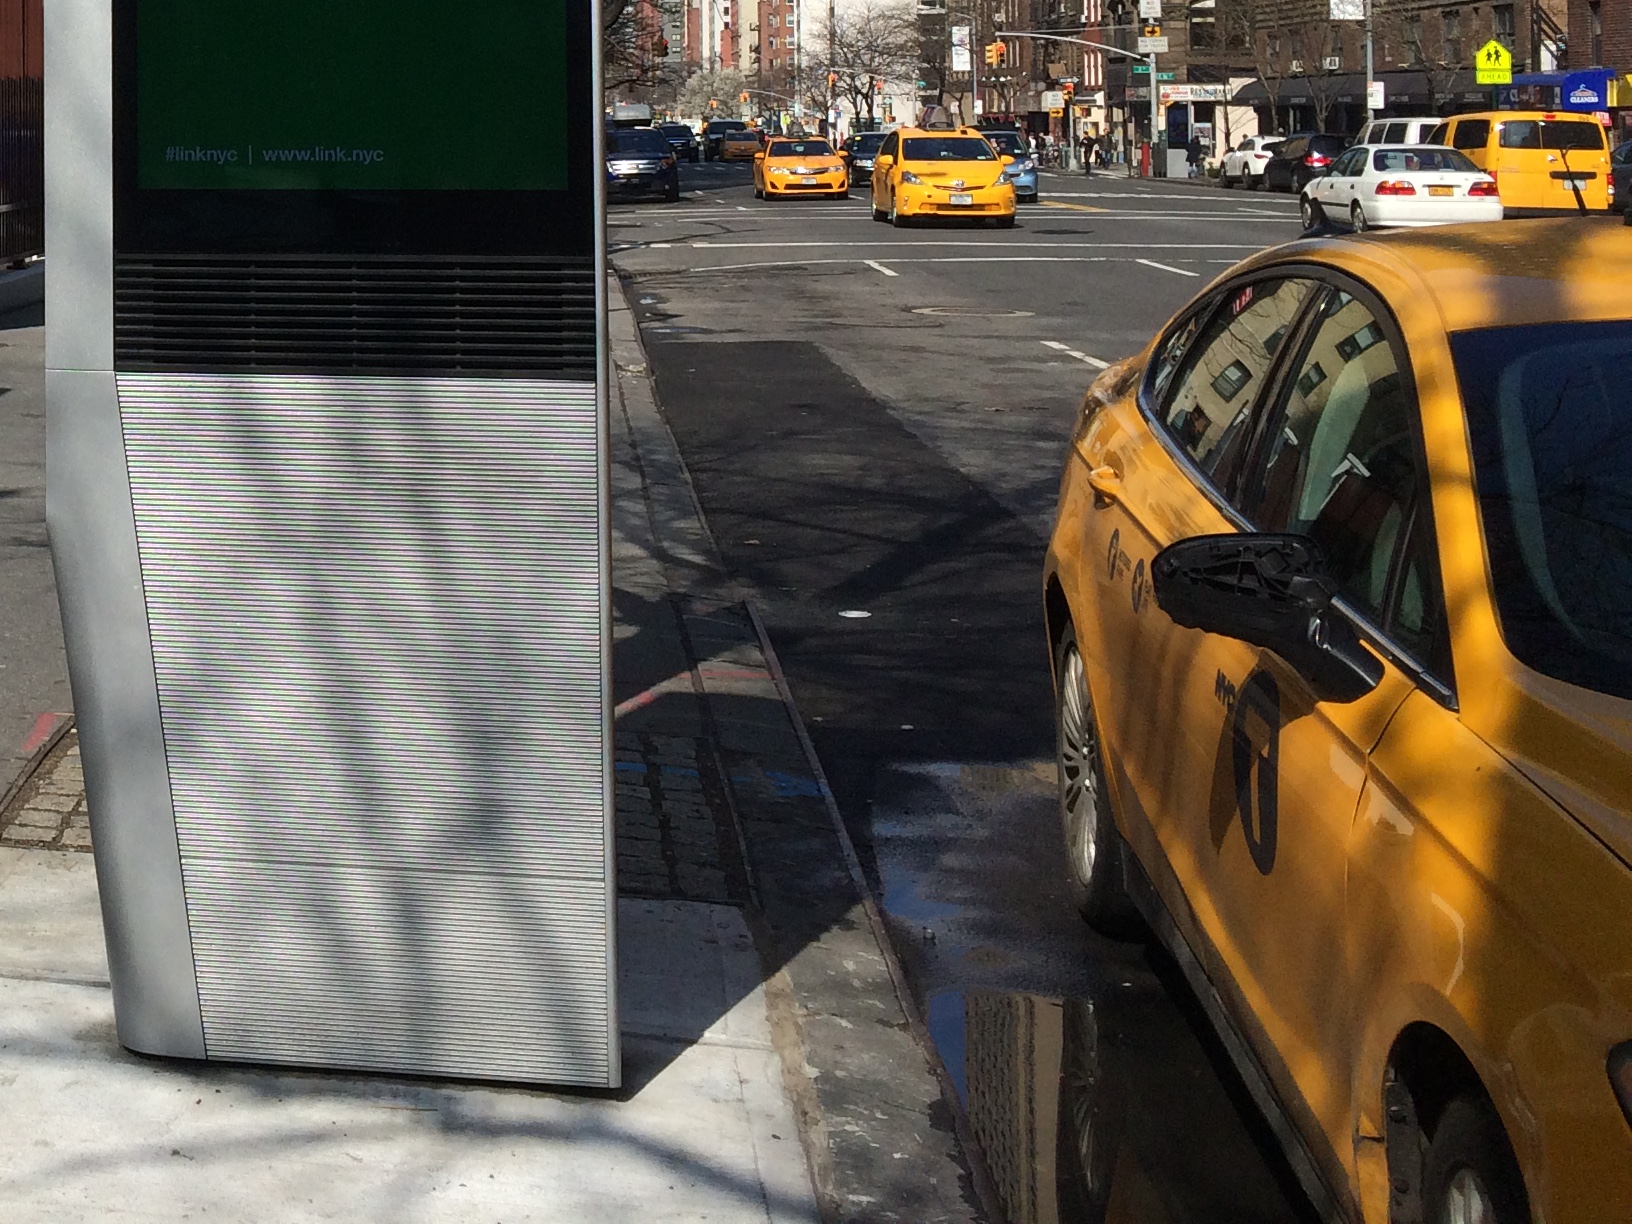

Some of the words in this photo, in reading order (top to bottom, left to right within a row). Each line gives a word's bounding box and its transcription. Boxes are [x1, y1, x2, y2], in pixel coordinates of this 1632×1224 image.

[1481, 73, 1508, 81] AHEAD
[1569, 96, 1599, 104] CLEANERS
[164, 146, 238, 165] #linknyc
[262, 146, 385, 165] www.link.nyc
